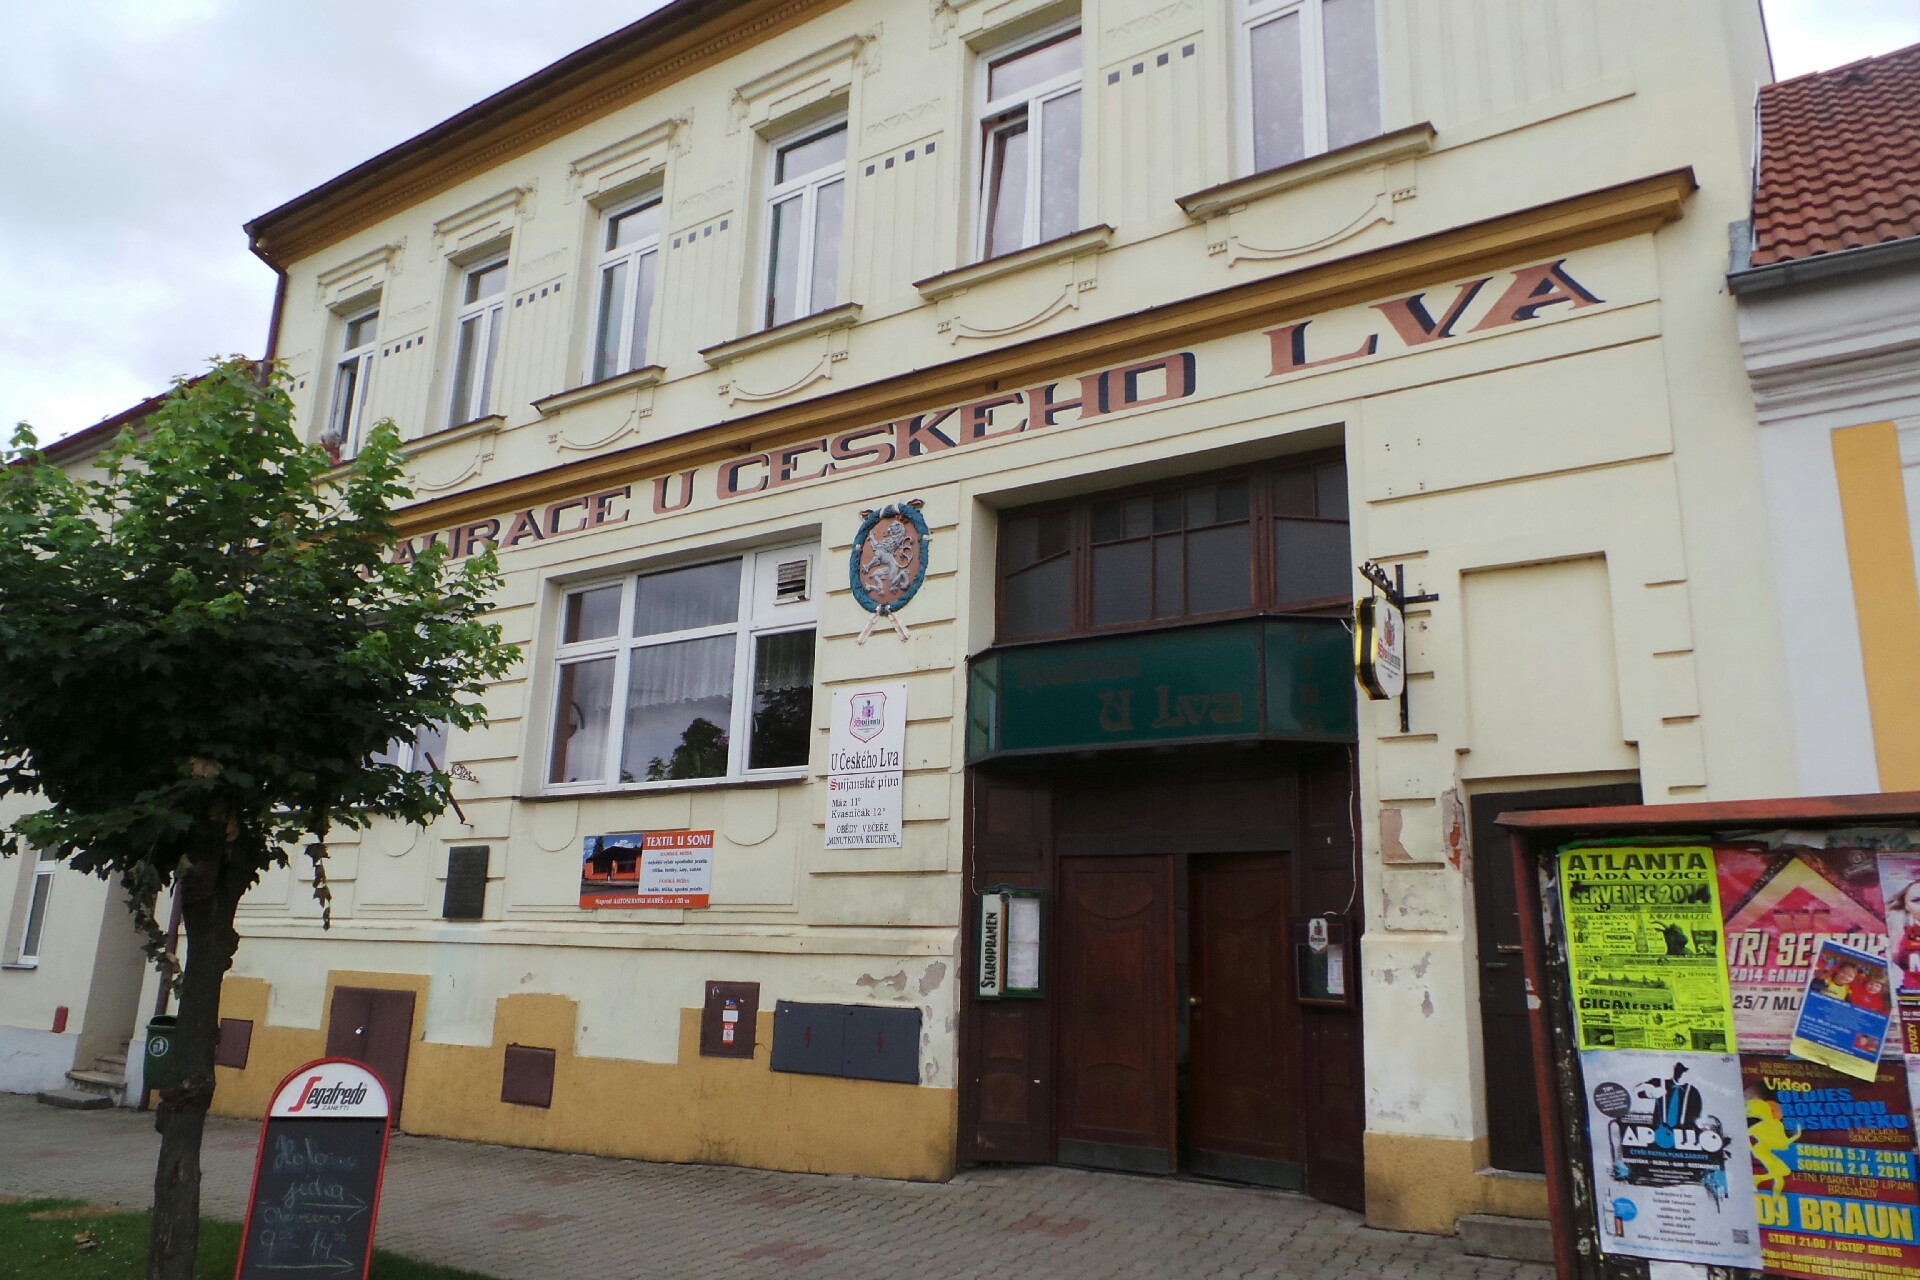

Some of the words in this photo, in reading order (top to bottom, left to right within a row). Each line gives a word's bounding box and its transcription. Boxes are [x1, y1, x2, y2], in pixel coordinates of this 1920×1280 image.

[361, 486, 632, 579] AURACE
[652, 469, 698, 515] U
[1262, 259, 1606, 378] LVA
[1151, 685, 1244, 730] Lva
[831, 753, 838, 771] U
[840, 748, 878, 771] Českého
[880, 747, 899, 767] Lva
[646, 836, 674, 847] TEXTIL
[677, 836, 684, 846] U
[686, 834, 711, 846] SONI
[1567, 853, 1707, 871] ATLANTA
[980, 912, 998, 989] STAROPRAMEN
[1728, 928, 1770, 967] TŘI
[1731, 968, 1763, 983] 2014
[1767, 969, 1810, 984] GAMB
[1580, 997, 1675, 1011] GIGAtresk
[1733, 995, 1768, 1010] 25/7
[287, 1076, 368, 1112] Segafredo
[1764, 1077, 1812, 1093] Video
[1777, 1088, 1852, 1103] OLDIES
[1782, 1101, 1887, 1117] ROKOVOU
[1783, 1115, 1909, 1131] DISKOTEKU
[1622, 1125, 1723, 1153] APOLLO
[1797, 1144, 1844, 1160] SOBOTA
[1848, 1147, 1871, 1161] 5.7.
[1876, 1150, 1908, 1164] 2014
[1797, 1158, 1845, 1173] SOBOTA
[1849, 1162, 1873, 1176] 2.8.
[1878, 1165, 1909, 1178] 2014
[1859, 1178, 1879, 1189] POD
[1799, 1197, 1914, 1241] BRAUN
[1768, 1233, 1796, 1246] START
[1835, 1241, 1866, 1254] VSTUP
[1868, 1245, 1903, 1258] GRATIS
